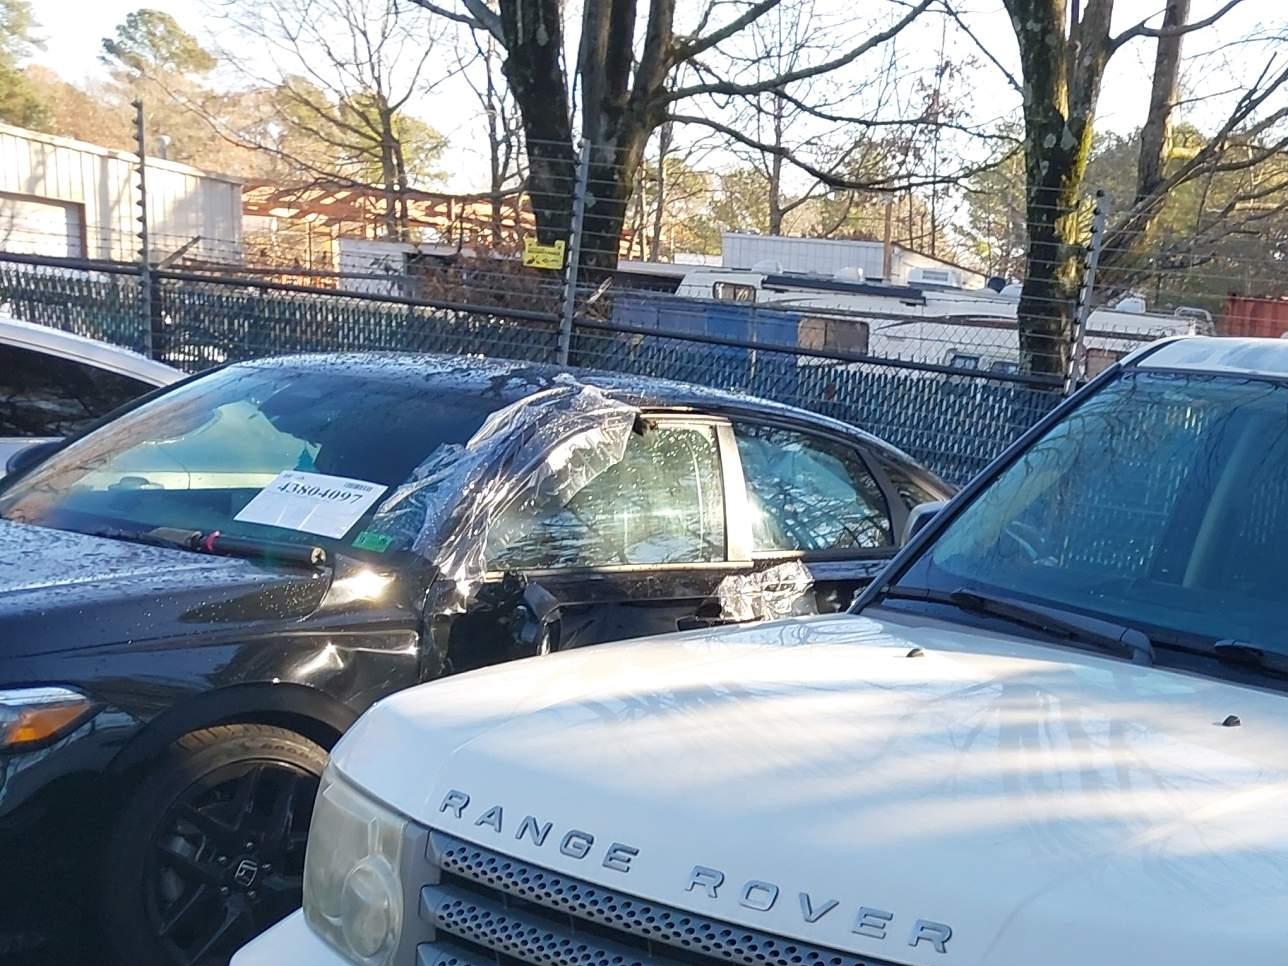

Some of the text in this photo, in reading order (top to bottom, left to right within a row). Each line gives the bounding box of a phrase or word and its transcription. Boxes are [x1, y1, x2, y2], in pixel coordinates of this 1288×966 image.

[277, 481, 363, 504] 43804097
[439, 789, 954, 954] RANGE ROVER
